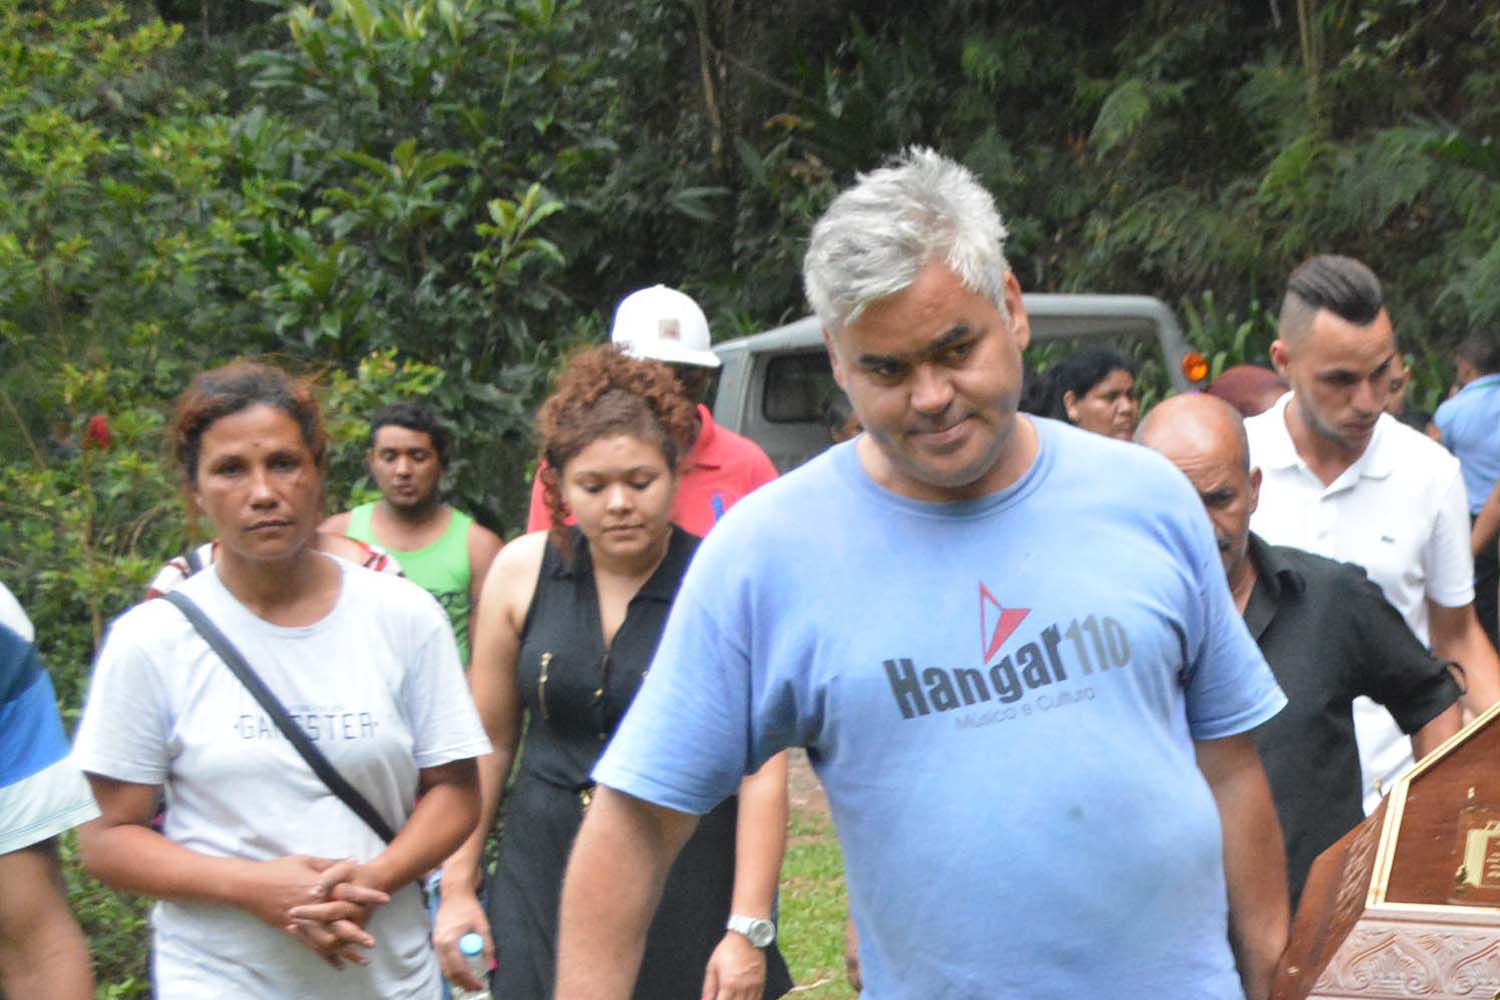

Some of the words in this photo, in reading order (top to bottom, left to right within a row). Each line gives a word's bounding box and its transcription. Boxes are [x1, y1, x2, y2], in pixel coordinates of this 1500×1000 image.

[884, 624, 1066, 719] Hangar
[1066, 614, 1131, 675] 110
[240, 712, 375, 740] GASTER
